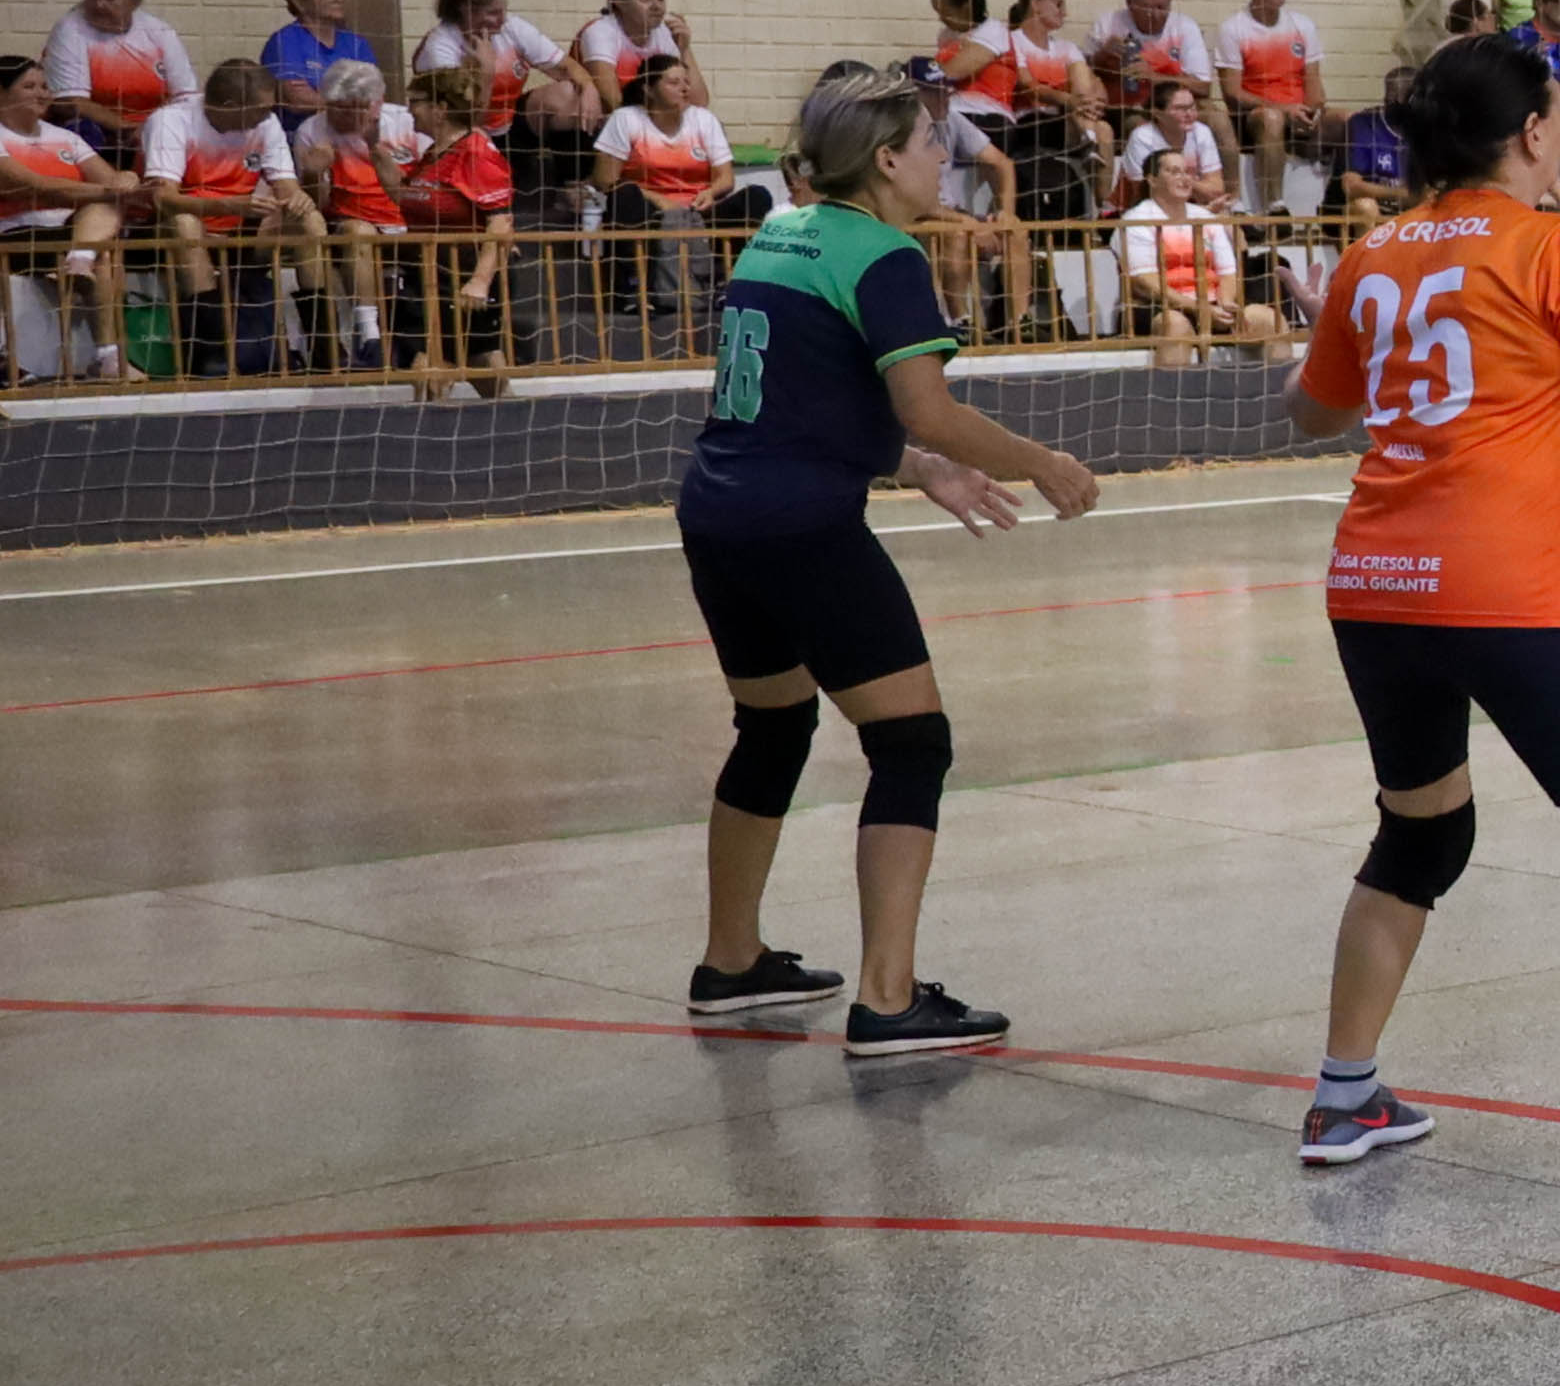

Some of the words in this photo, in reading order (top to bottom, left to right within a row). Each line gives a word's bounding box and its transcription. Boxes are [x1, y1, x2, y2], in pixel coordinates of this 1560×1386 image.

[1398, 216, 1492, 244] CRESOL
[1350, 266, 1475, 427] 25
[1360, 555, 1415, 572] CRESOL
[1417, 556, 1443, 572] DE
[1369, 576, 1440, 593] GIGANTE
